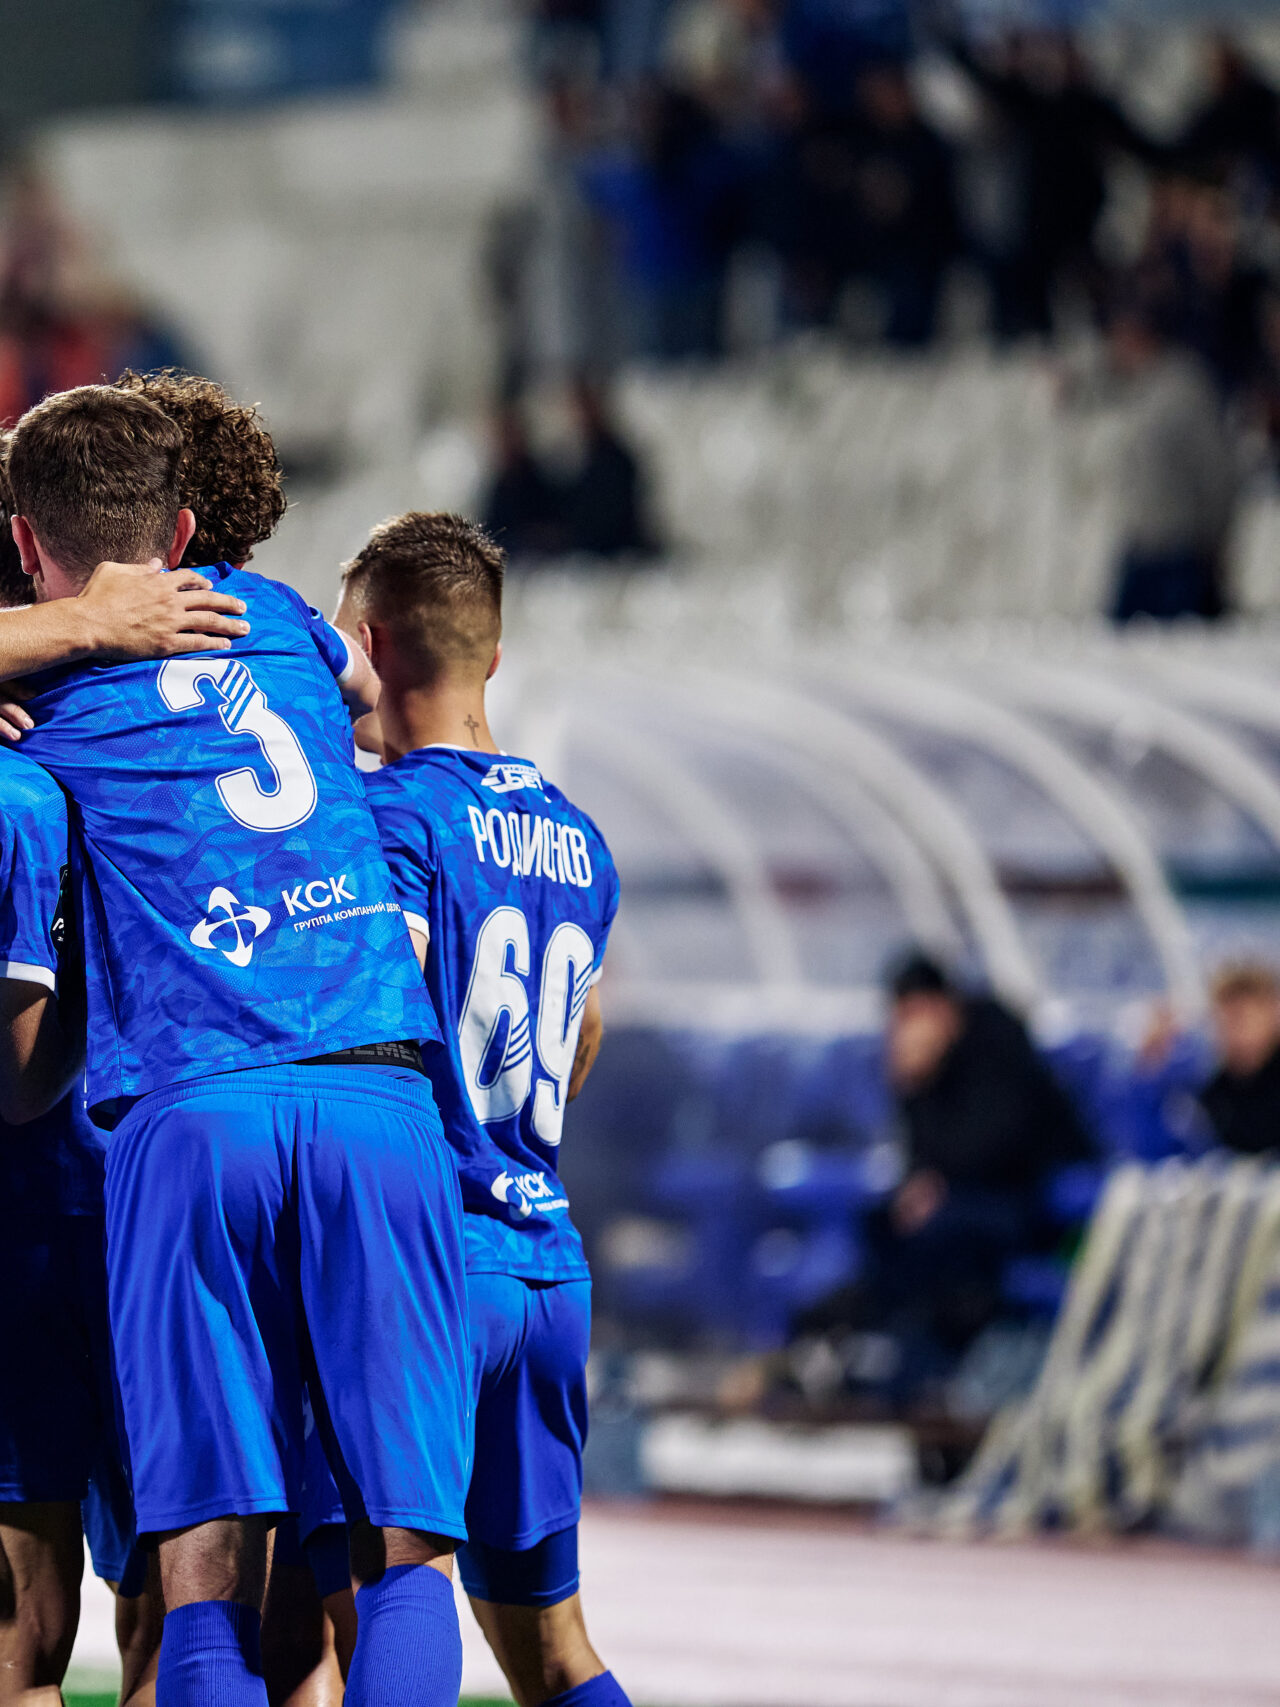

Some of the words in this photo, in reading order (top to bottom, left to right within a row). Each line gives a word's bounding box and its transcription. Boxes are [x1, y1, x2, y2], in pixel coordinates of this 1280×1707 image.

[157, 658, 318, 833] 3
[281, 874, 357, 917] КСК
[293, 913, 334, 933] ГРУППА
[333, 901, 386, 921] КОМПАНИЙ
[458, 905, 595, 1147] 69
